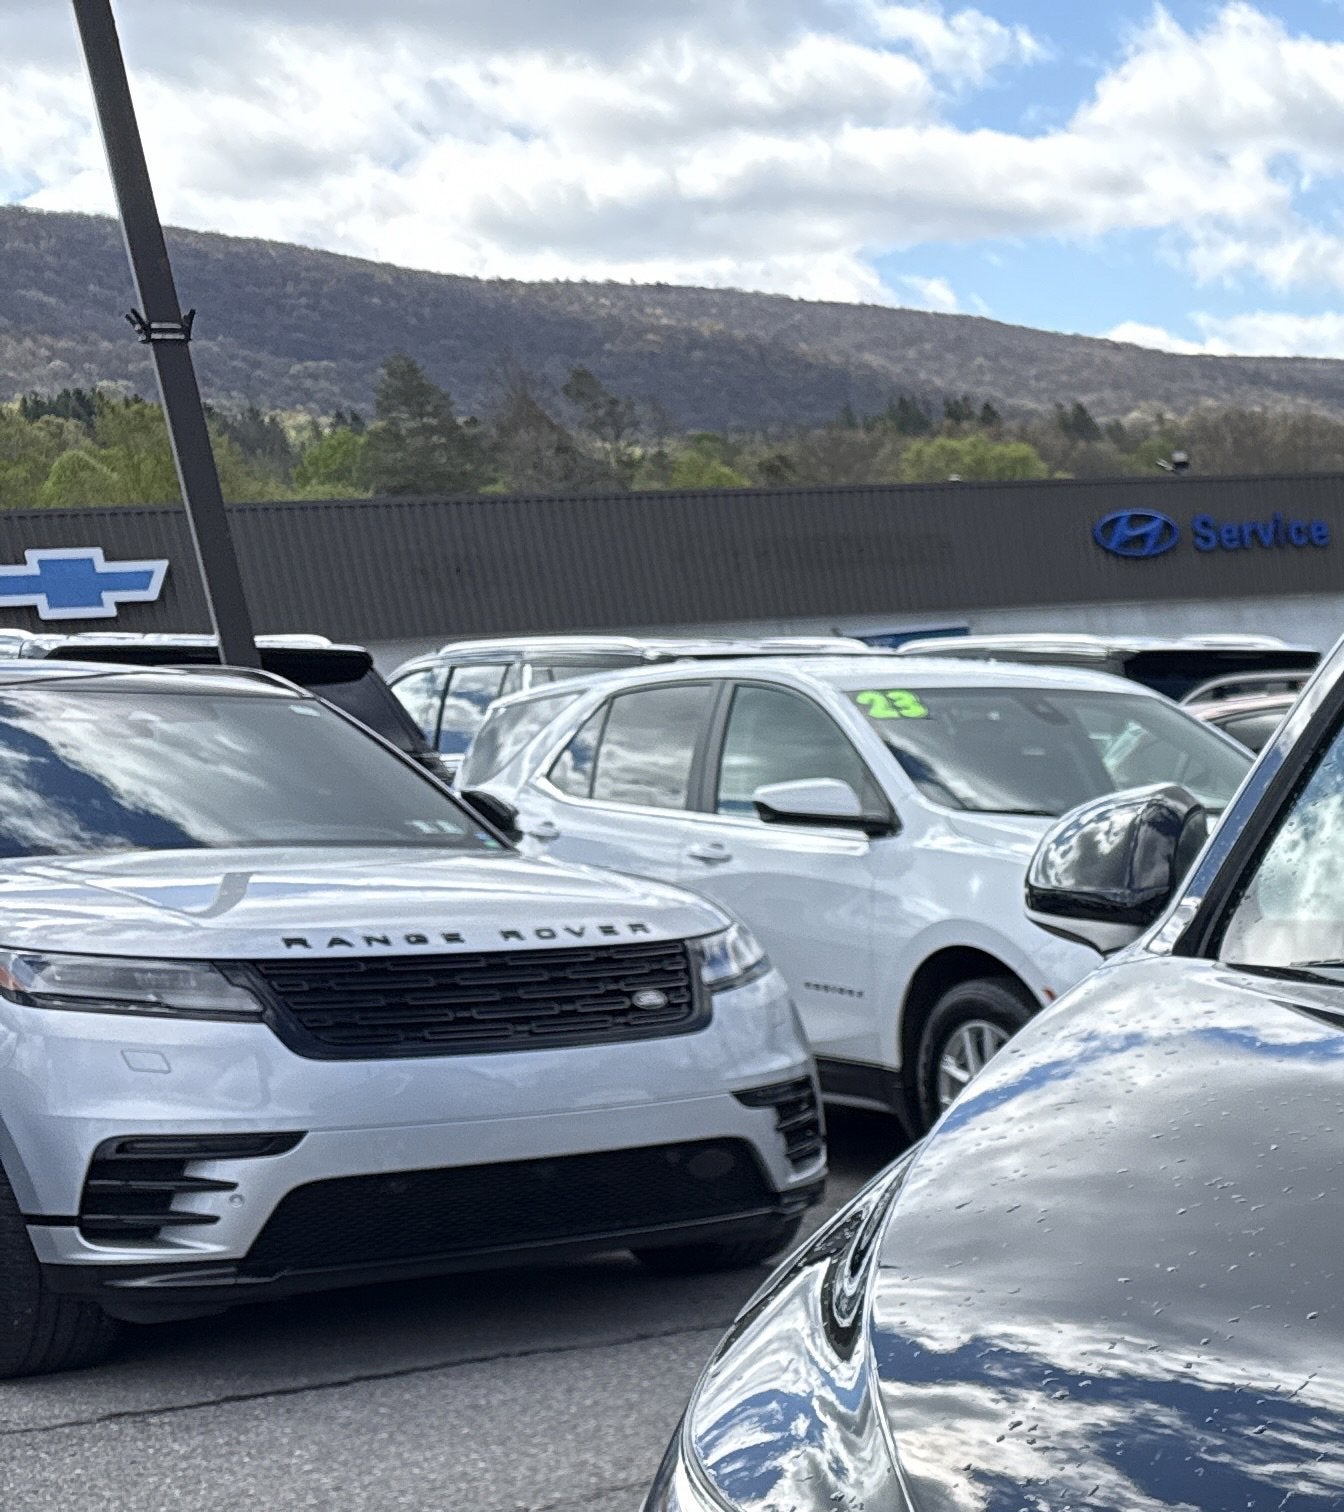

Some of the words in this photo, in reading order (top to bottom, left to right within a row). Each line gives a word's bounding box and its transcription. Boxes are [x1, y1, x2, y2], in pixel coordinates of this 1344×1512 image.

[1191, 512, 1330, 551] Service
[856, 690, 928, 719] 23
[281, 932, 466, 949] RANGE
[500, 922, 651, 942] ROVER
